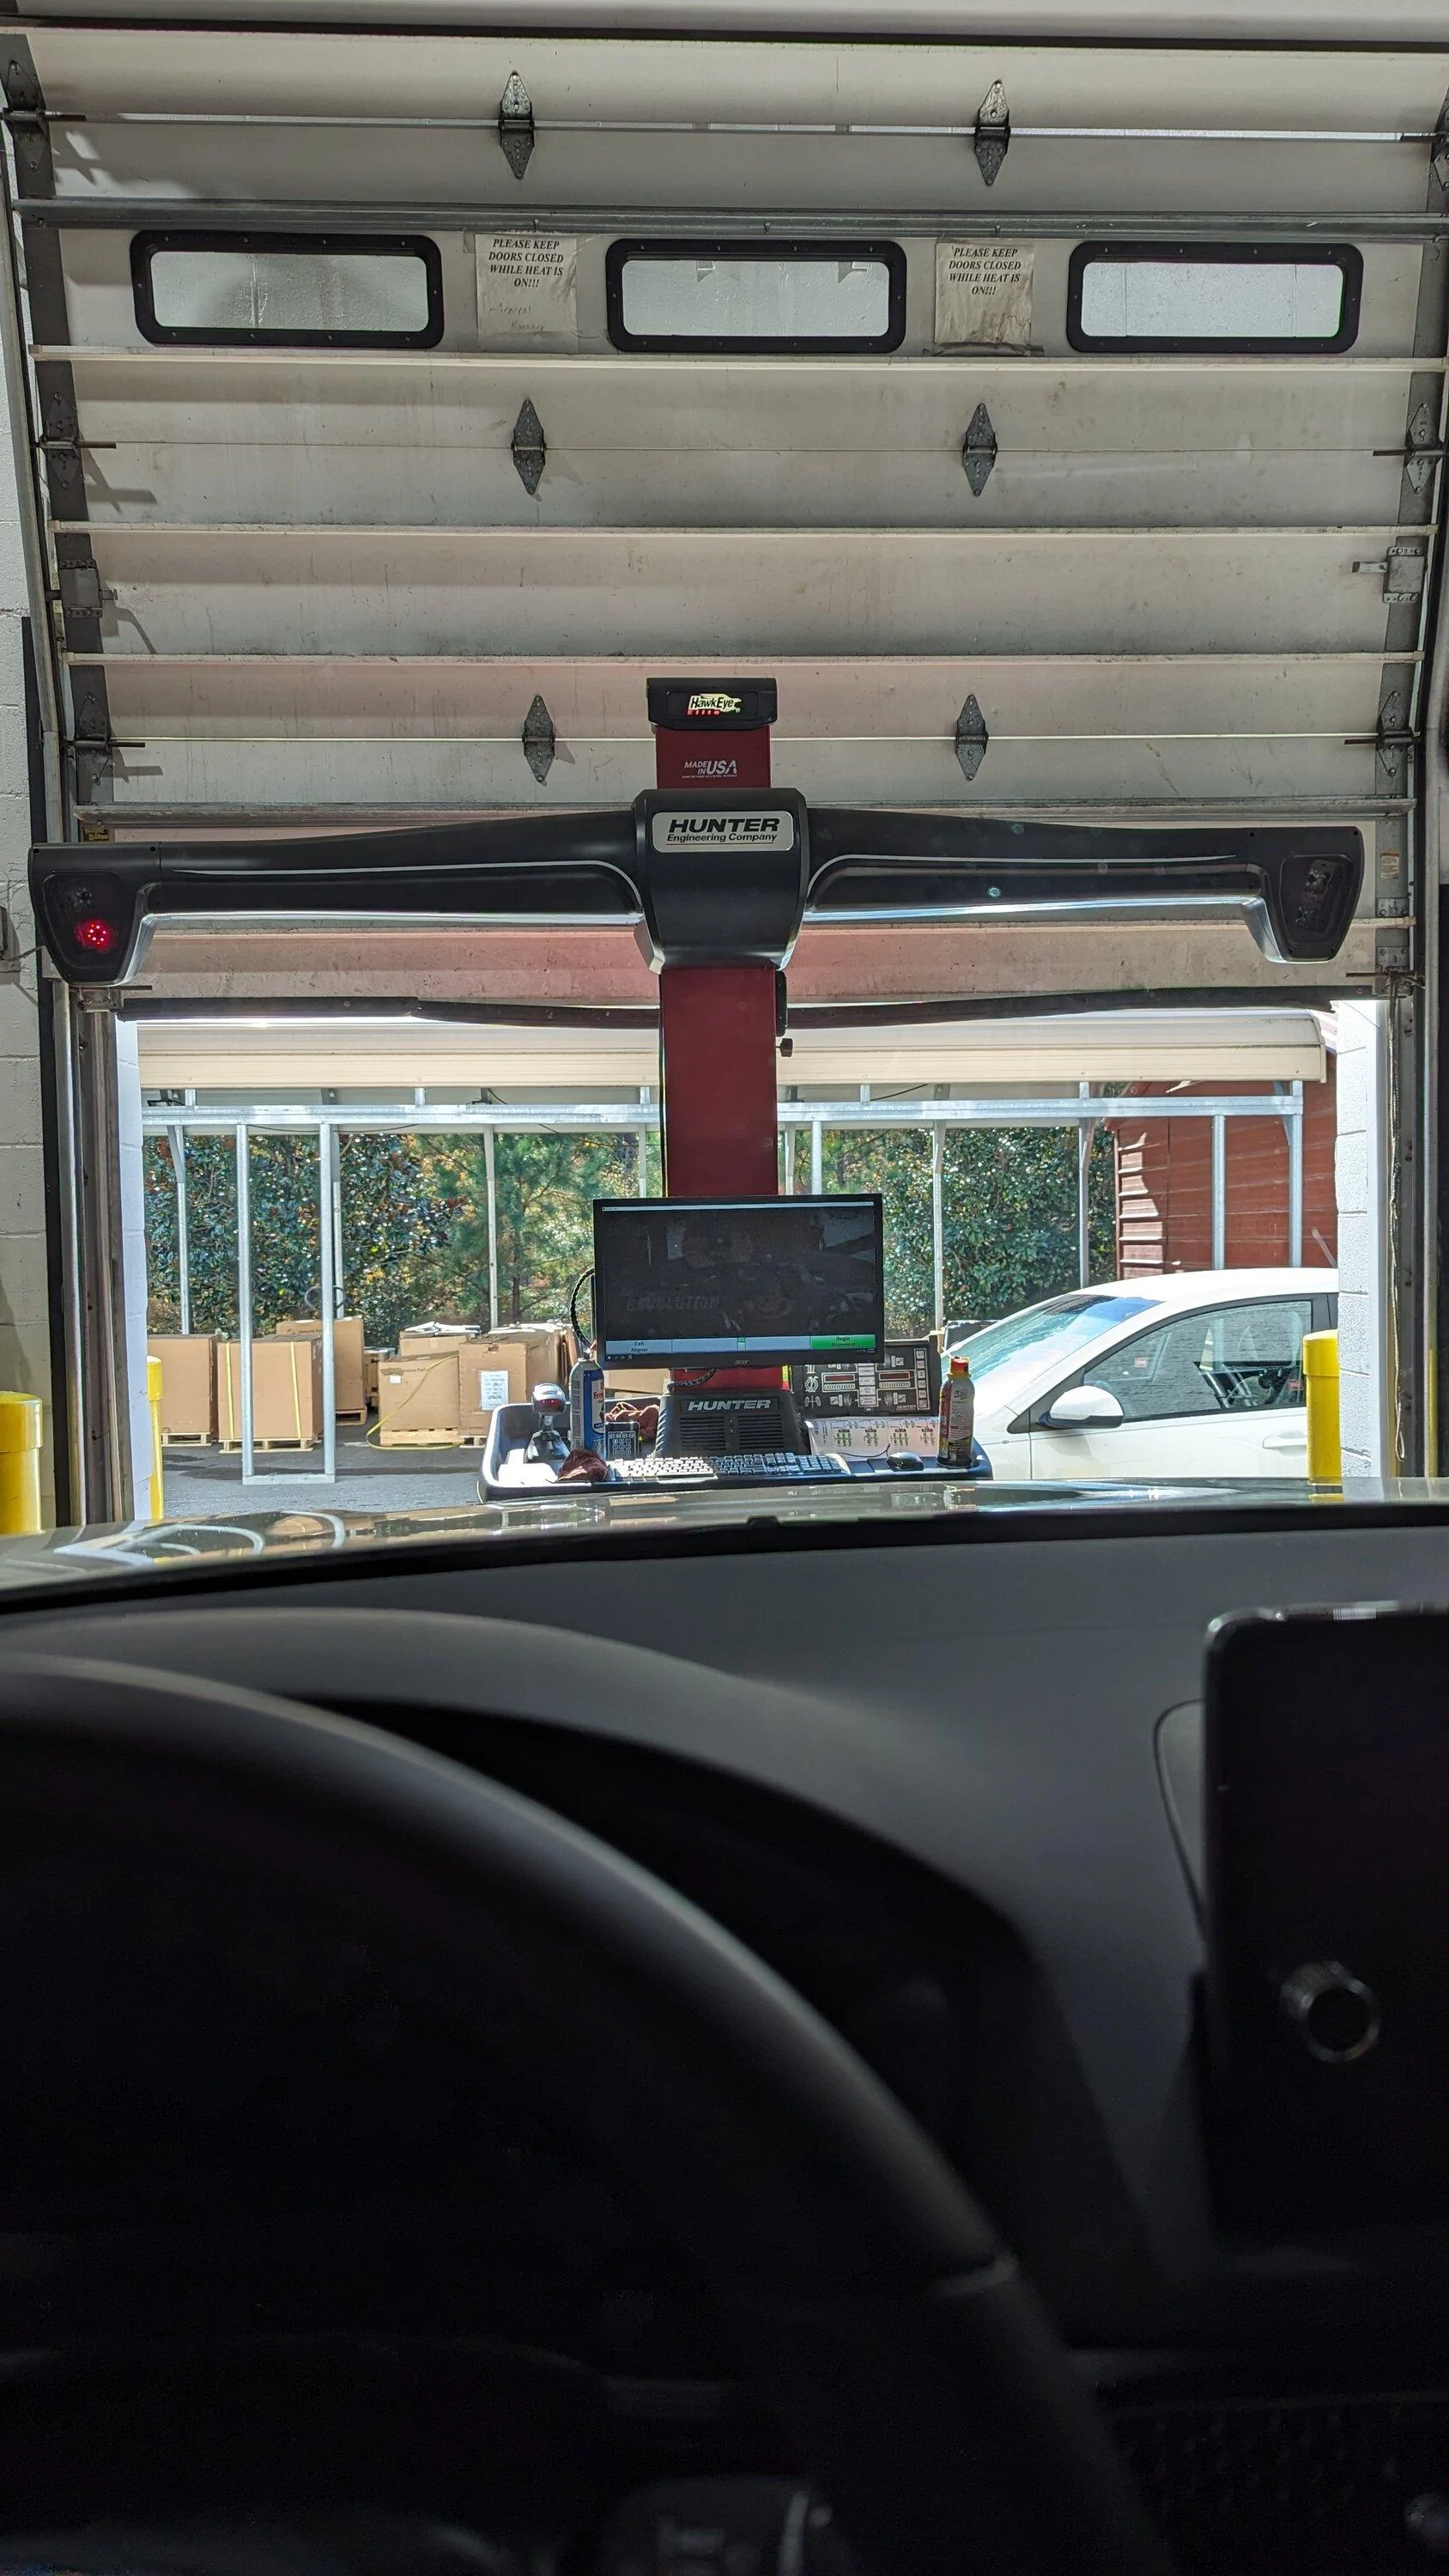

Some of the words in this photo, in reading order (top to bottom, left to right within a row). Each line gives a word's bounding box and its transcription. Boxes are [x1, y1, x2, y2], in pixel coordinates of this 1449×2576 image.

[493, 239, 530, 248] PLEASE
[533, 240, 560, 250] KEEP
[488, 252, 522, 262] DOORS
[524, 253, 564, 263] CLOSED
[953, 247, 990, 258] PLEASE
[991, 248, 1018, 258] KEEP
[490, 264, 523, 275] WHILE
[524, 265, 552, 276] HEAT
[554, 266, 563, 276] IS
[949, 260, 982, 270] DOORS
[983, 261, 1022, 270] CLOSED
[513, 278, 540, 288] ON!!!
[949, 273, 980, 283] WHILE
[983, 274, 1009, 283] HEAT
[1010, 274, 1021, 283] IS
[972, 286, 997, 295] ON!!!
[690, 697, 734, 709] HawkEye
[707, 760, 737, 774] USA
[669, 818, 779, 833] HUNTER
[667, 833, 726, 843] Engineering
[729, 833, 777, 841] Company
[688, 1399, 772, 1412] HUNTER
